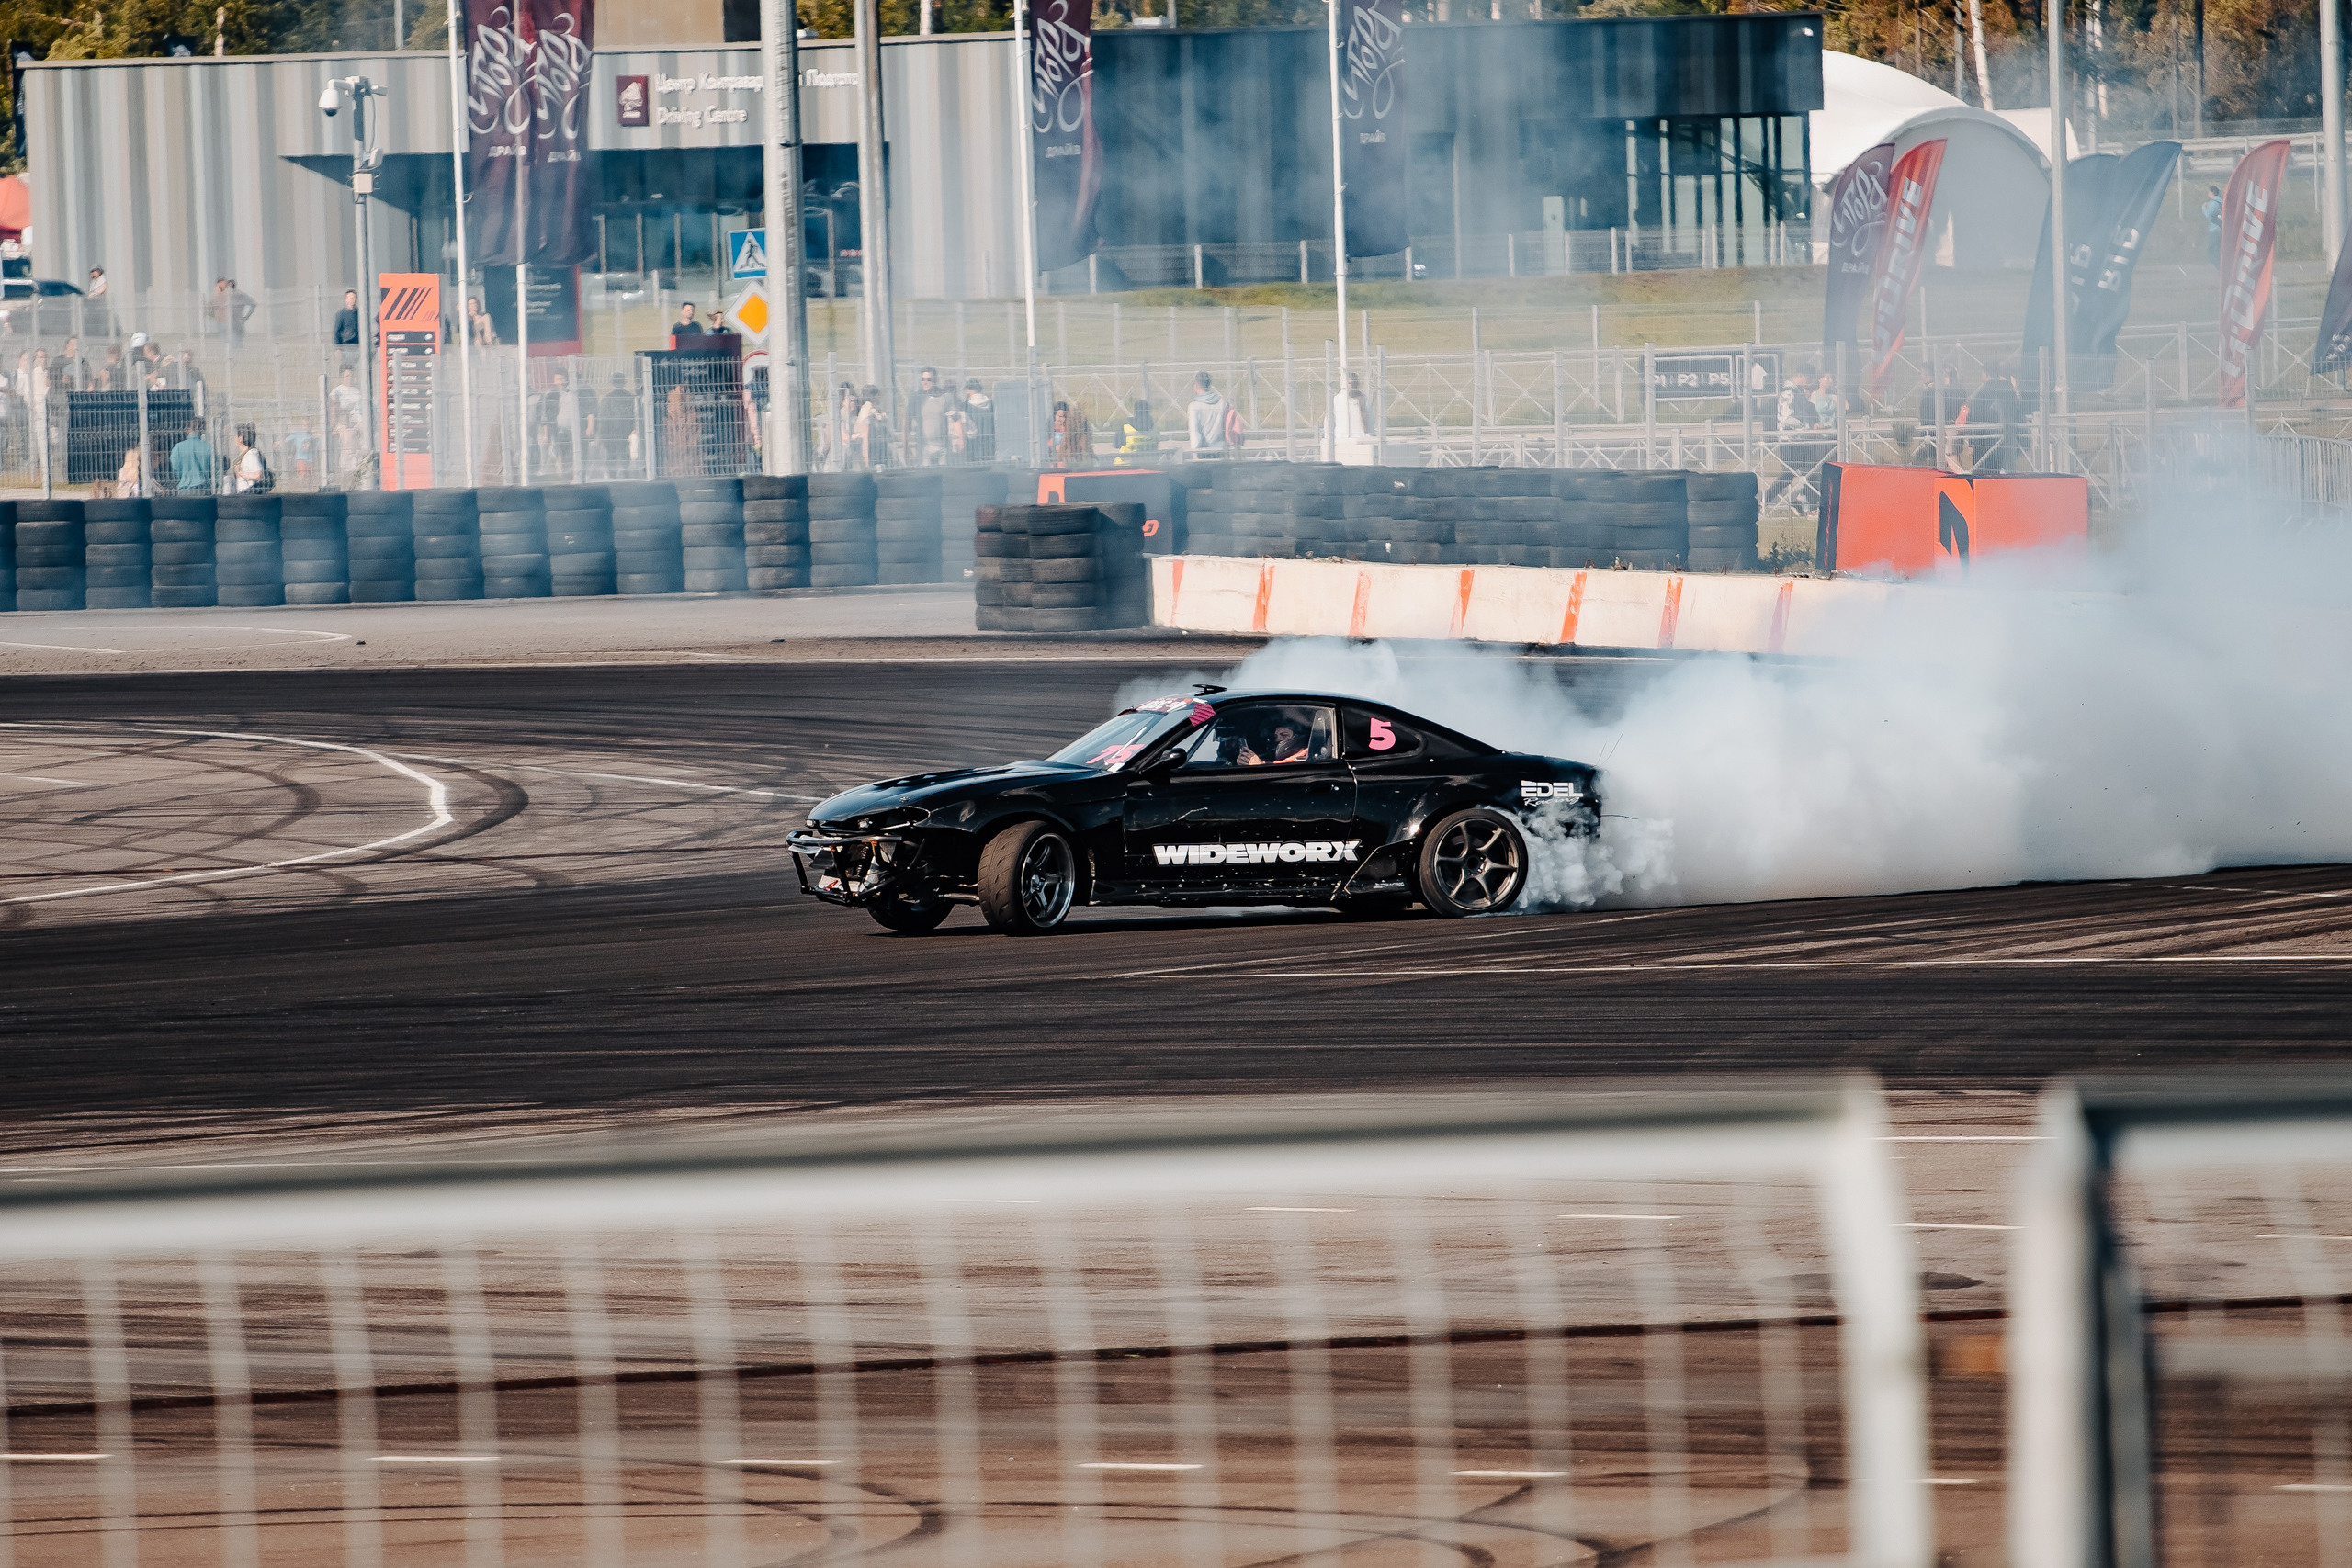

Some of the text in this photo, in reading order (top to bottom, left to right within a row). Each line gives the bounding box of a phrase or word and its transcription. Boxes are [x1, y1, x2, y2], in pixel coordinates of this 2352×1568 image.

[658, 106, 702, 128] Driving
[1677, 373, 1699, 388] P2
[1708, 372, 1730, 386] P5
[1369, 717, 1396, 750] 5
[1085, 743, 1146, 764] 75
[1521, 780, 1584, 797] EDEL
[1153, 840, 1361, 866] WIDEWORX
